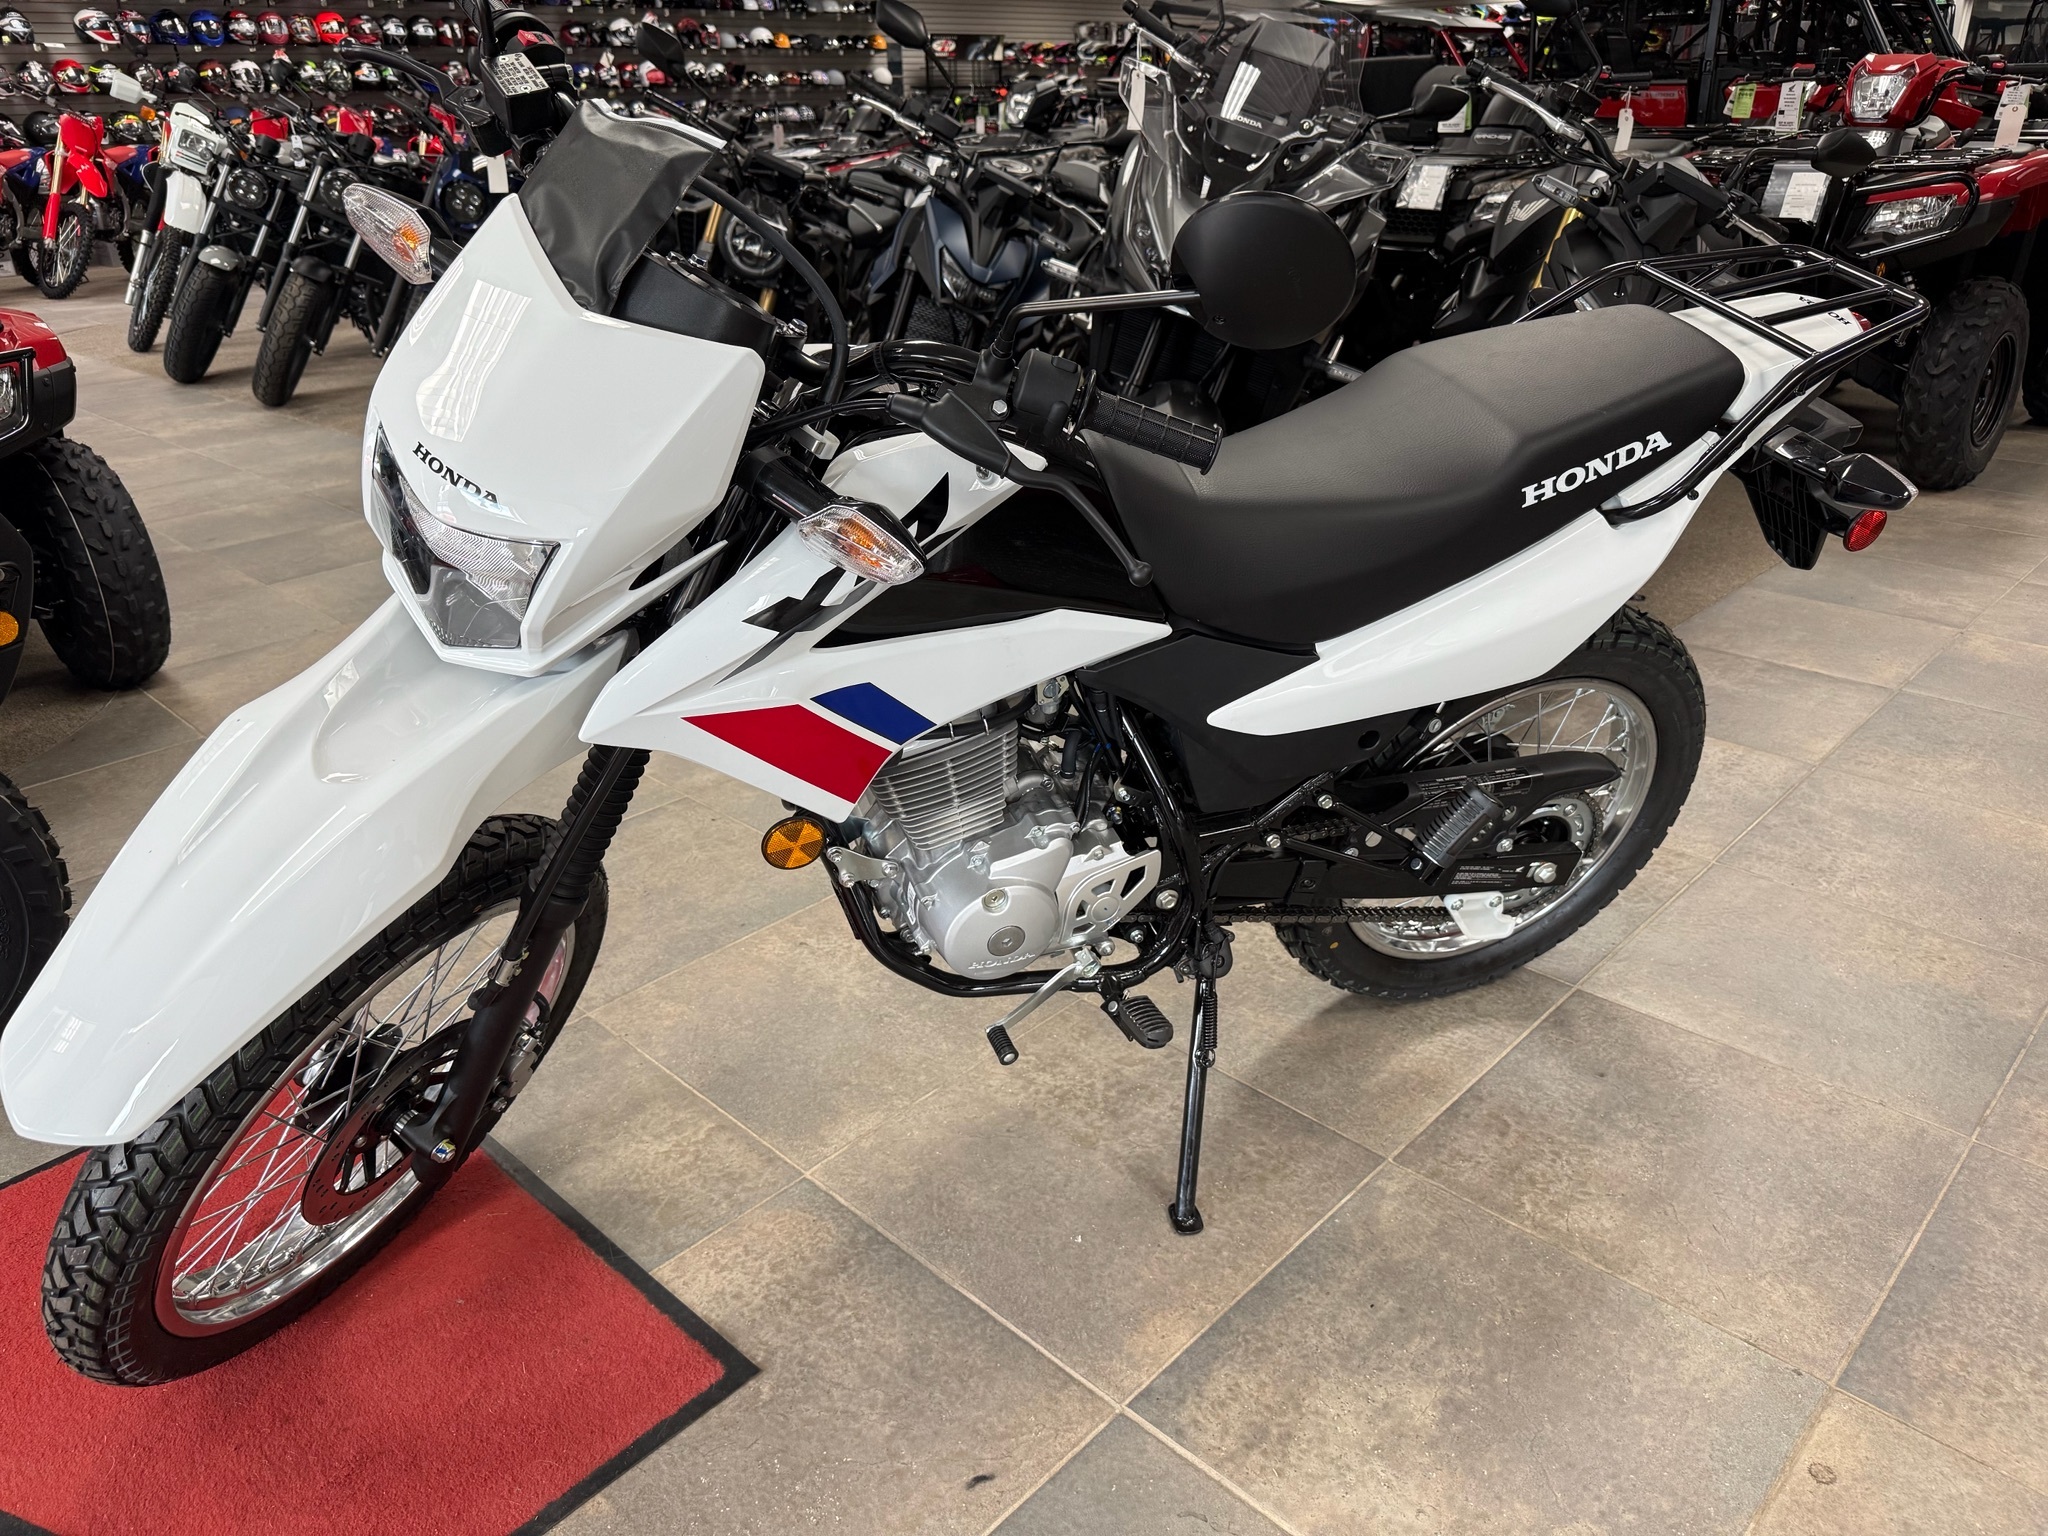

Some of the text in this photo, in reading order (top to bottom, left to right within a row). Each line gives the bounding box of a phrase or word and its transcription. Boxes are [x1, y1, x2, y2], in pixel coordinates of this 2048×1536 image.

[412, 441, 501, 510] HONDA
[1521, 430, 1673, 509] HONDA
[967, 952, 1036, 970] HONDA
